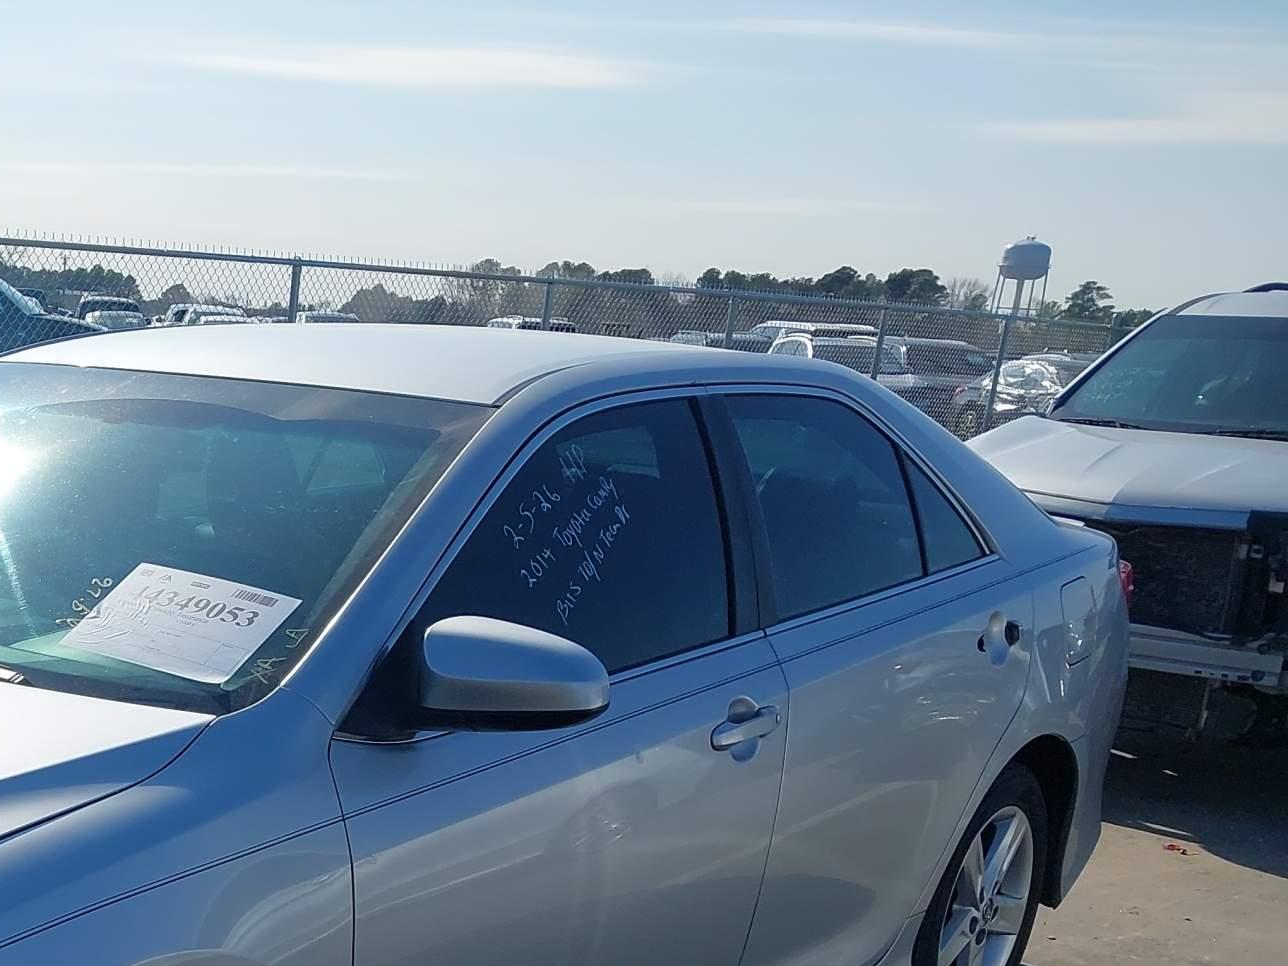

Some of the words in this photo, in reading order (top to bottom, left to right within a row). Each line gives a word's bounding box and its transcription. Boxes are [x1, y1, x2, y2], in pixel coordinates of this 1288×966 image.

[503, 484, 561, 550] 2-5-26
[520, 547, 556, 588] 2014
[552, 509, 592, 548] Toyota
